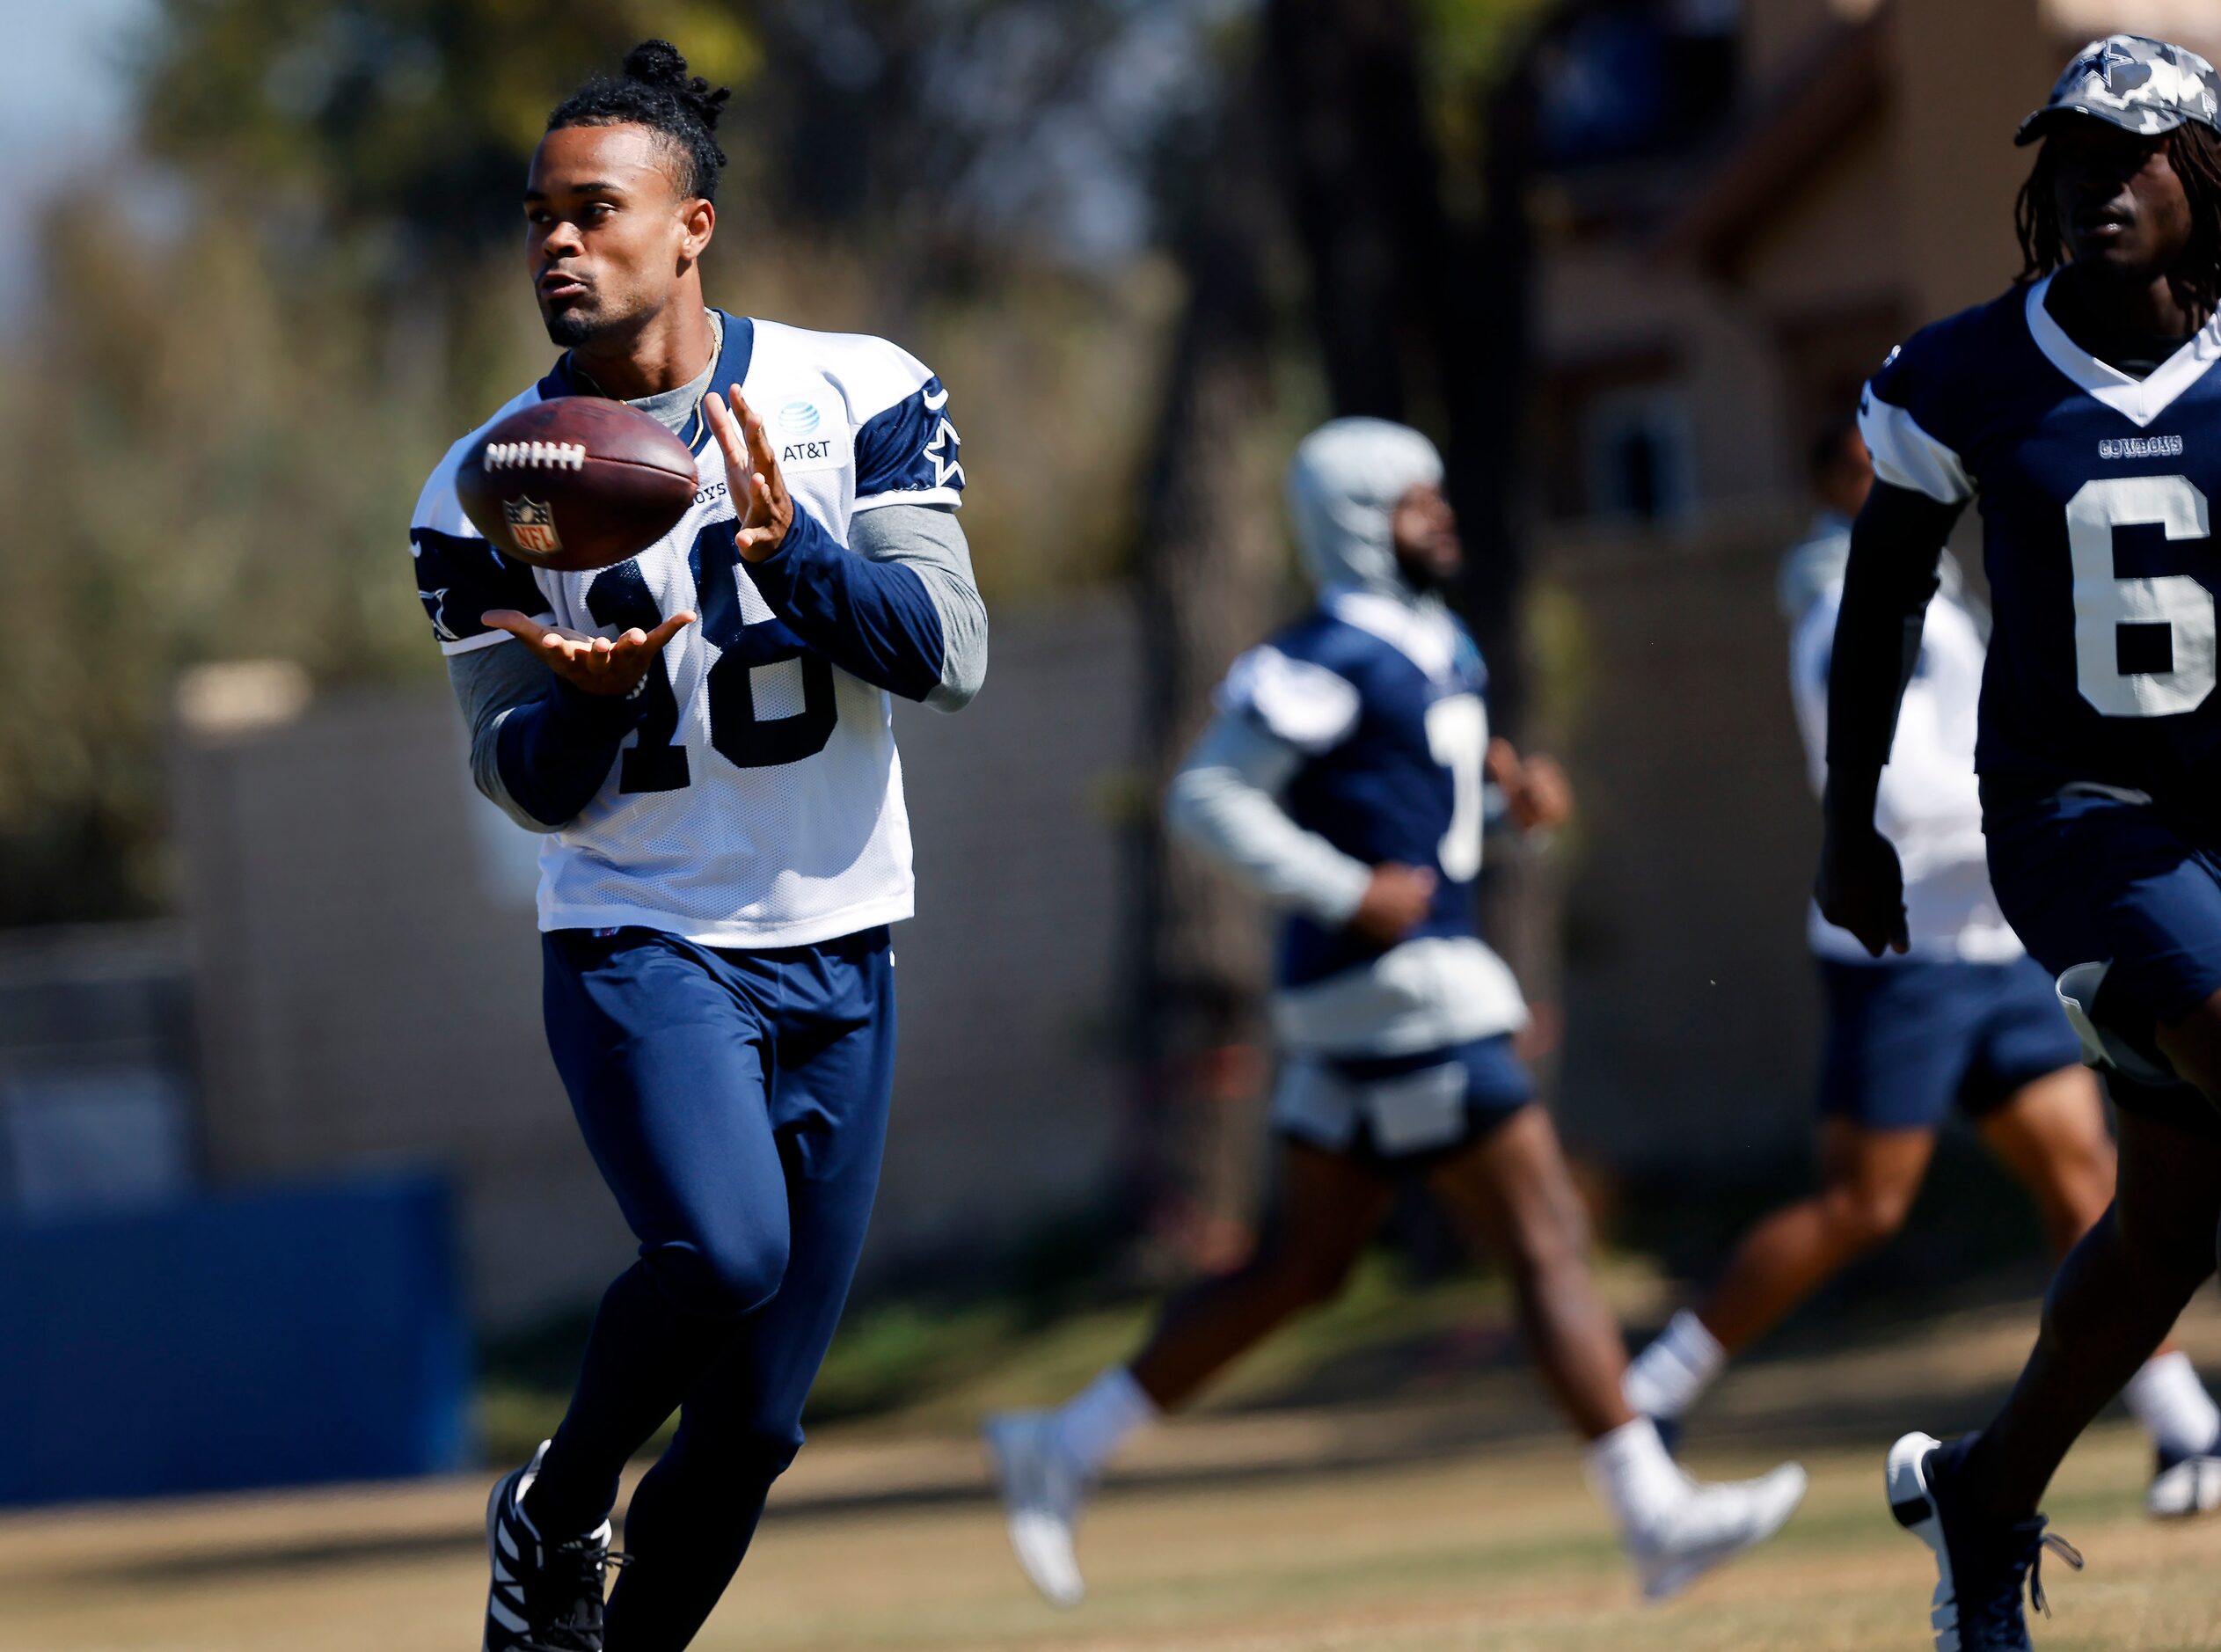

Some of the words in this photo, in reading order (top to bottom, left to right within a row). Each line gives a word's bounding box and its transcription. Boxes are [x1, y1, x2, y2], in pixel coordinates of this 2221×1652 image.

[783, 440, 830, 462] AT&T
[2098, 435, 2183, 459] COWBOYS
[694, 482, 727, 504] OYS
[512, 525, 557, 553] NFL
[2065, 475, 2217, 717] 6
